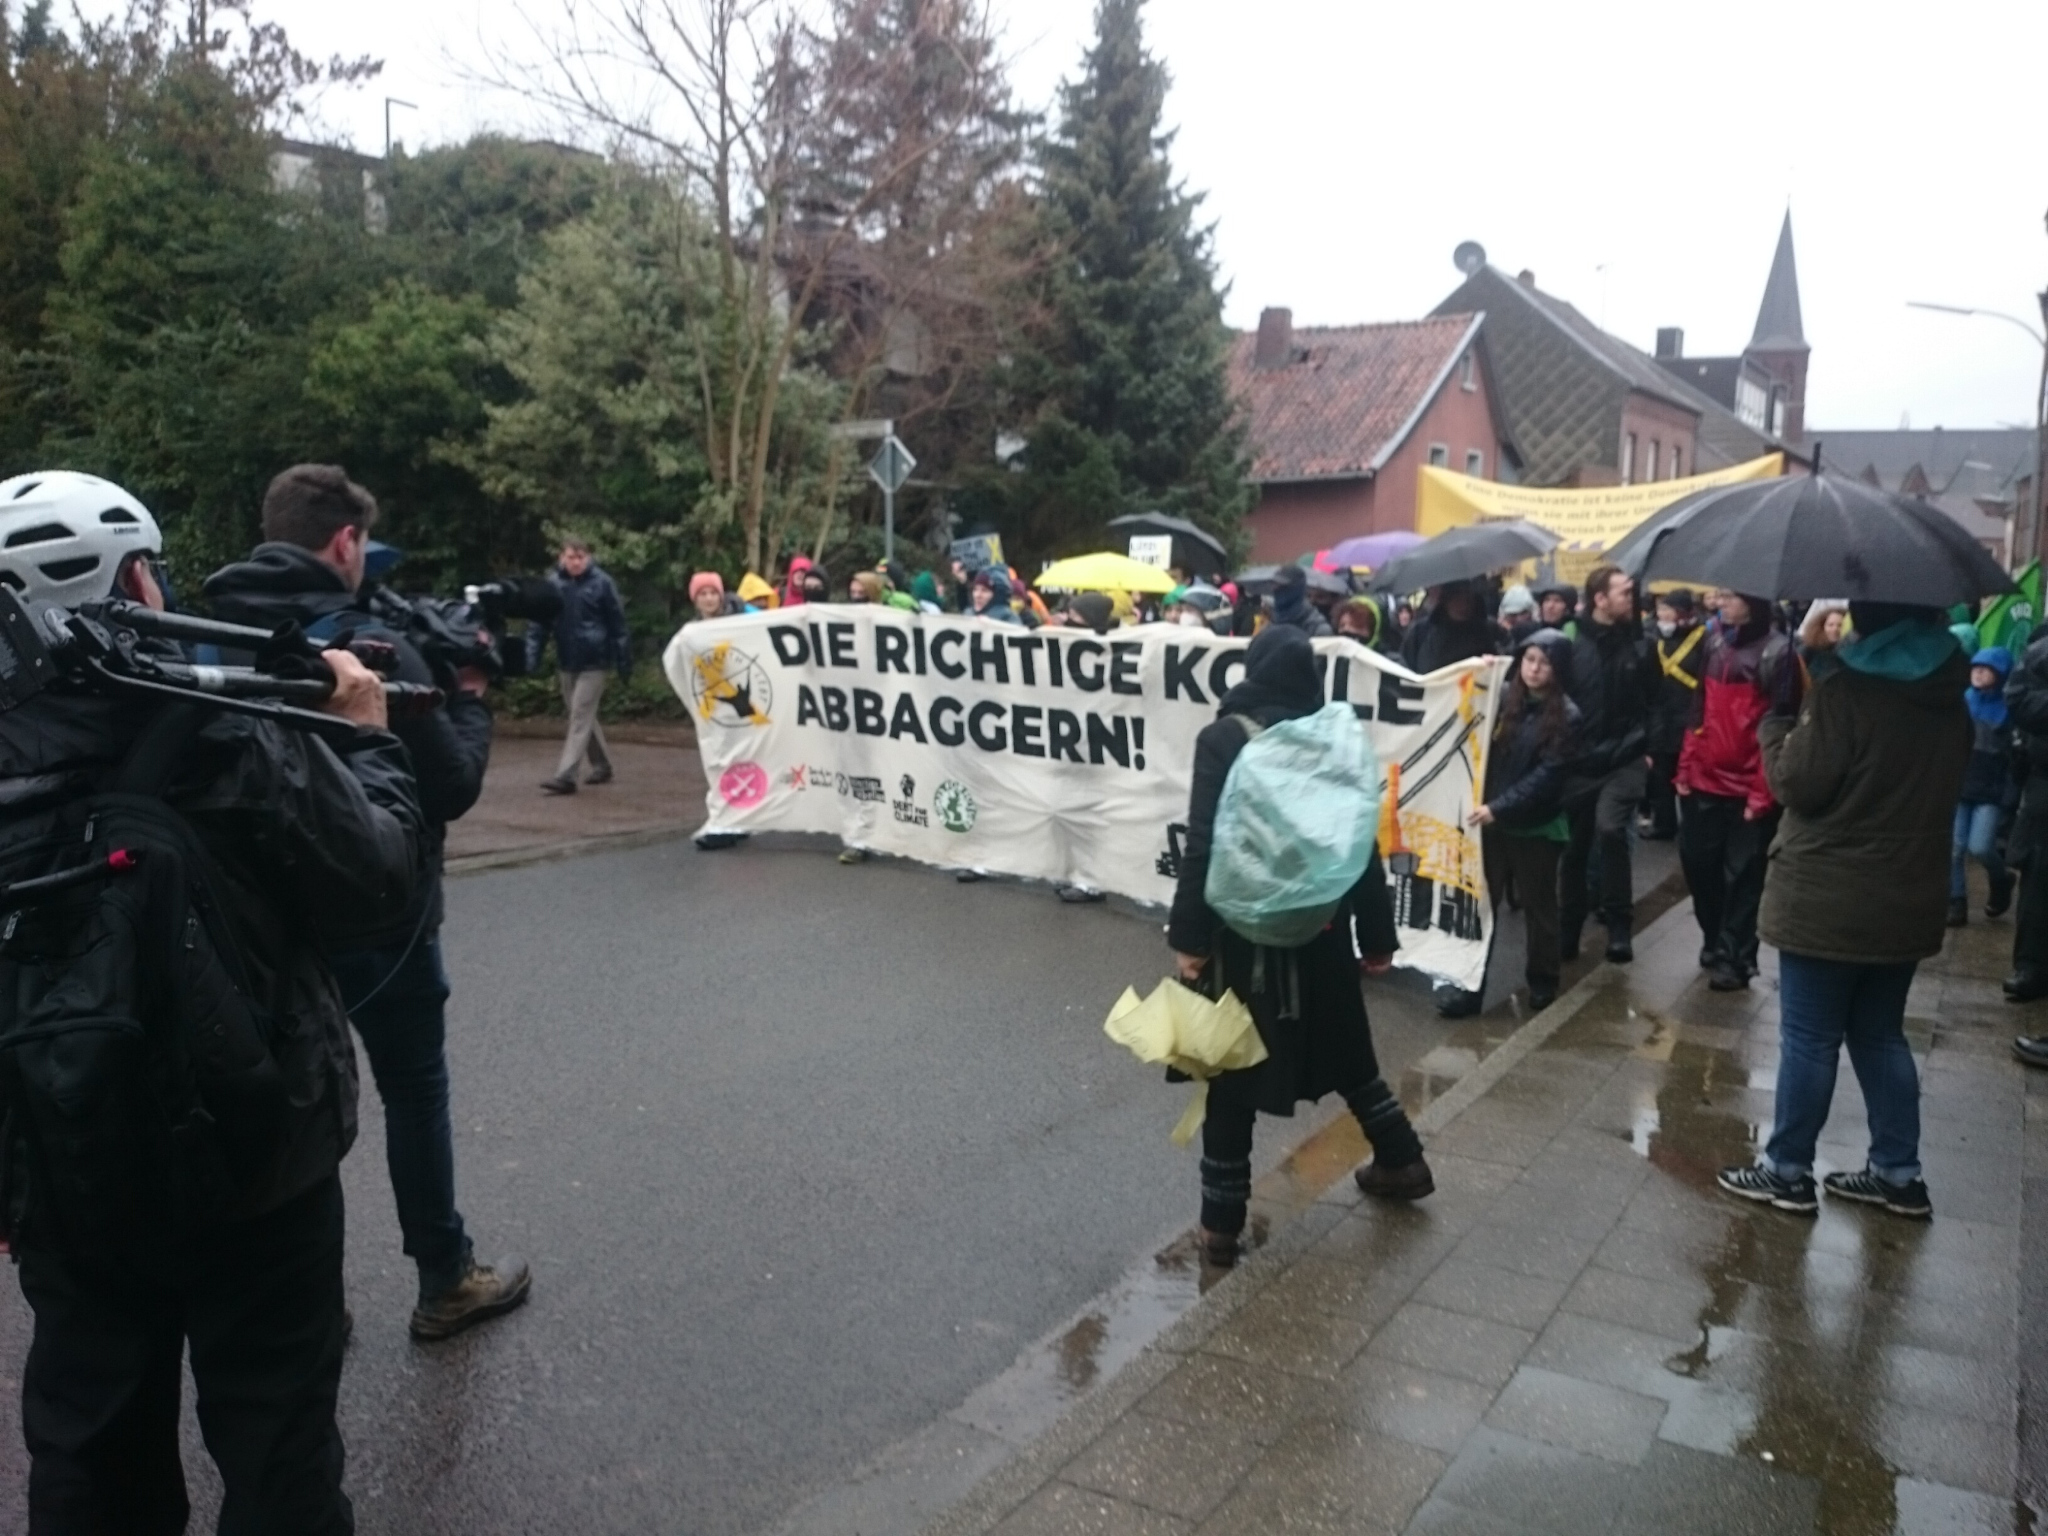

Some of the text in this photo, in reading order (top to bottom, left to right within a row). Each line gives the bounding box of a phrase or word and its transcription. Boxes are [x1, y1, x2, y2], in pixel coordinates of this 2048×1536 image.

[1497, 489, 1578, 505] Demokratie
[1583, 494, 1600, 504] ist
[767, 623, 1426, 726] DIE RICHTIGE KOLE
[797, 685, 1146, 771] ABBAGGERN!
[894, 810, 930, 829] CLIMATE
